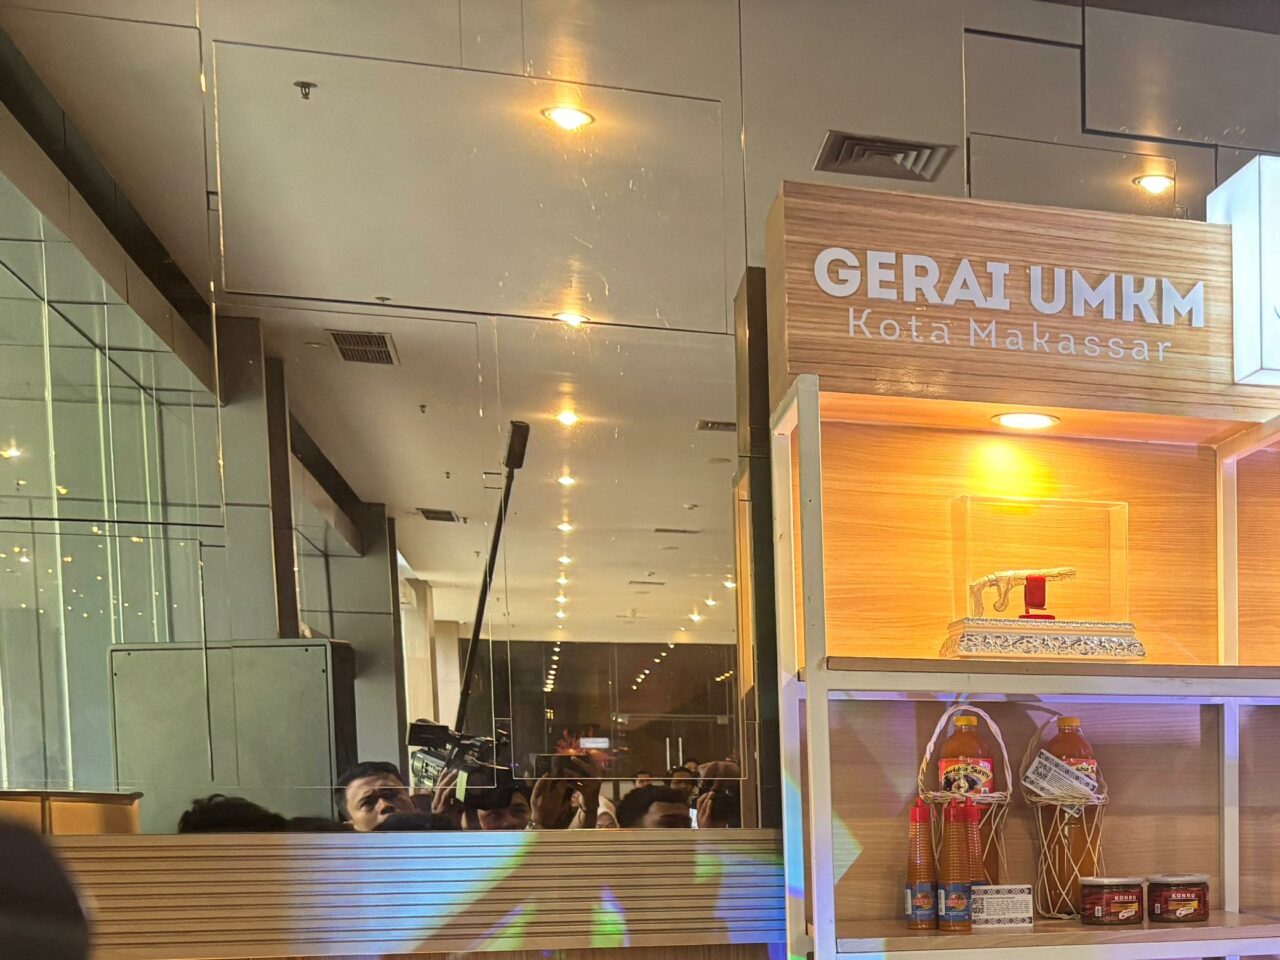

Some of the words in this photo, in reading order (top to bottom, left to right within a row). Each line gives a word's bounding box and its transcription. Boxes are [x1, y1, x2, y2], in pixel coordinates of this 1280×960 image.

[813, 246, 1010, 311] GERAI
[1030, 266, 1204, 328] UMKM
[848, 307, 950, 345] Kota
[969, 318, 1172, 363] Makassar
